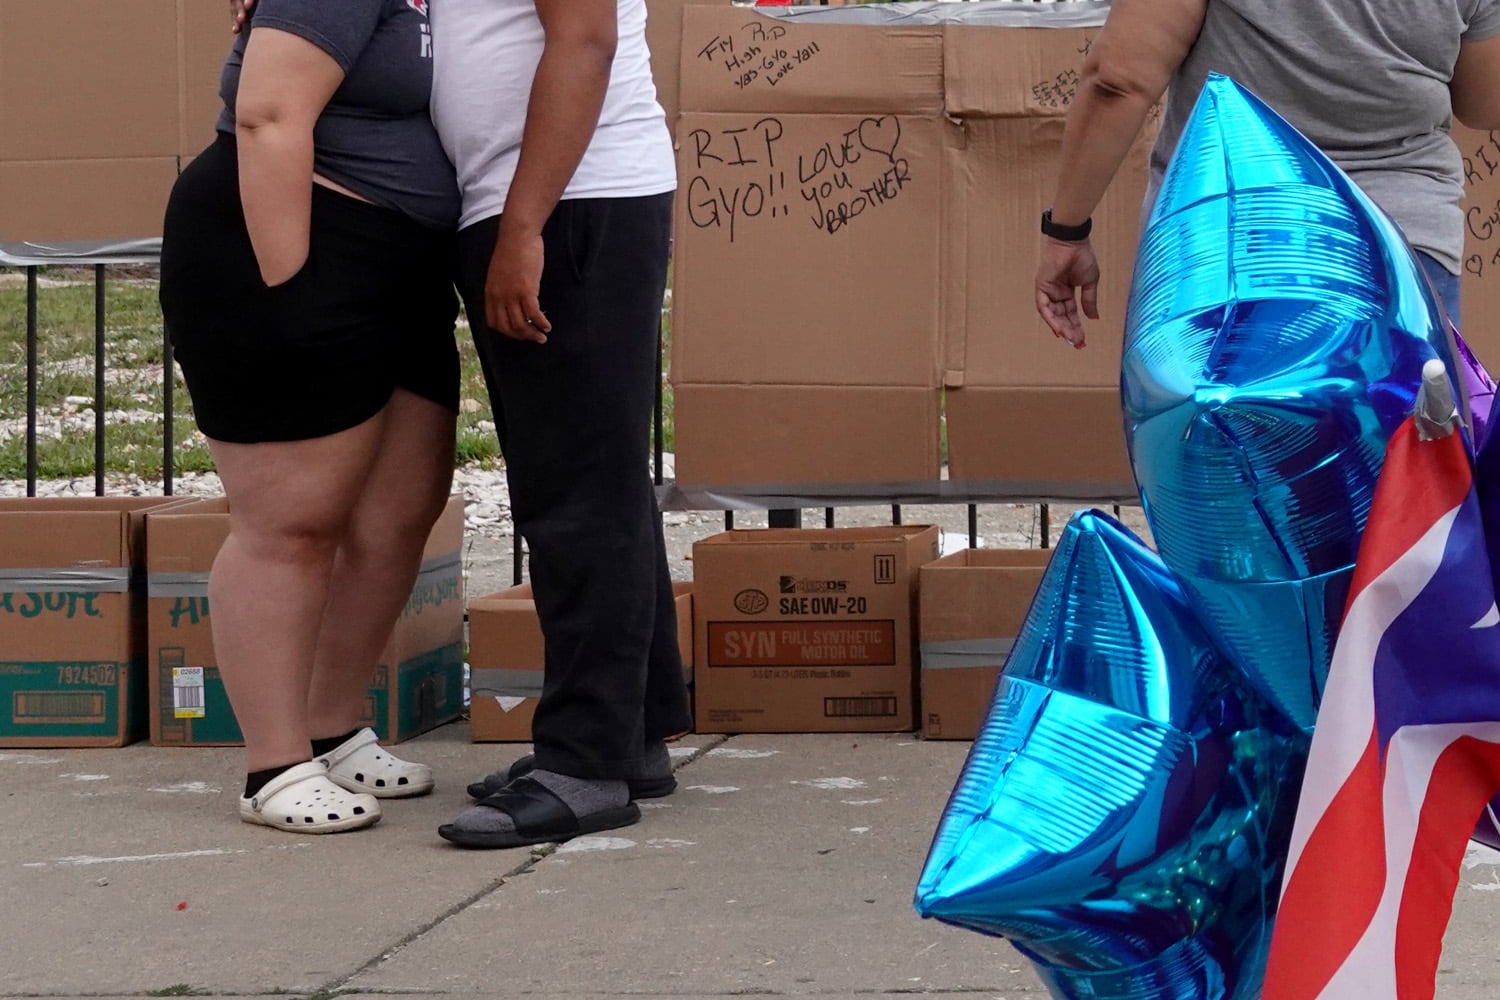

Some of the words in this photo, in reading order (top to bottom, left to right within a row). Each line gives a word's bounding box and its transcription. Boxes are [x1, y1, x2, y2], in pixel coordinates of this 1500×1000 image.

[697, 35, 734, 61] Fly
[688, 117, 783, 168] RIP
[799, 128, 861, 183] LOVE
[826, 158, 910, 234] BROTHER
[780, 597, 808, 615] SAE
[724, 630, 777, 659] SYN
[781, 630, 809, 645] FULL
[813, 630, 882, 645] SYNTHETIC
[801, 646, 846, 660] MOTOR
[850, 645, 868, 659] OIL
